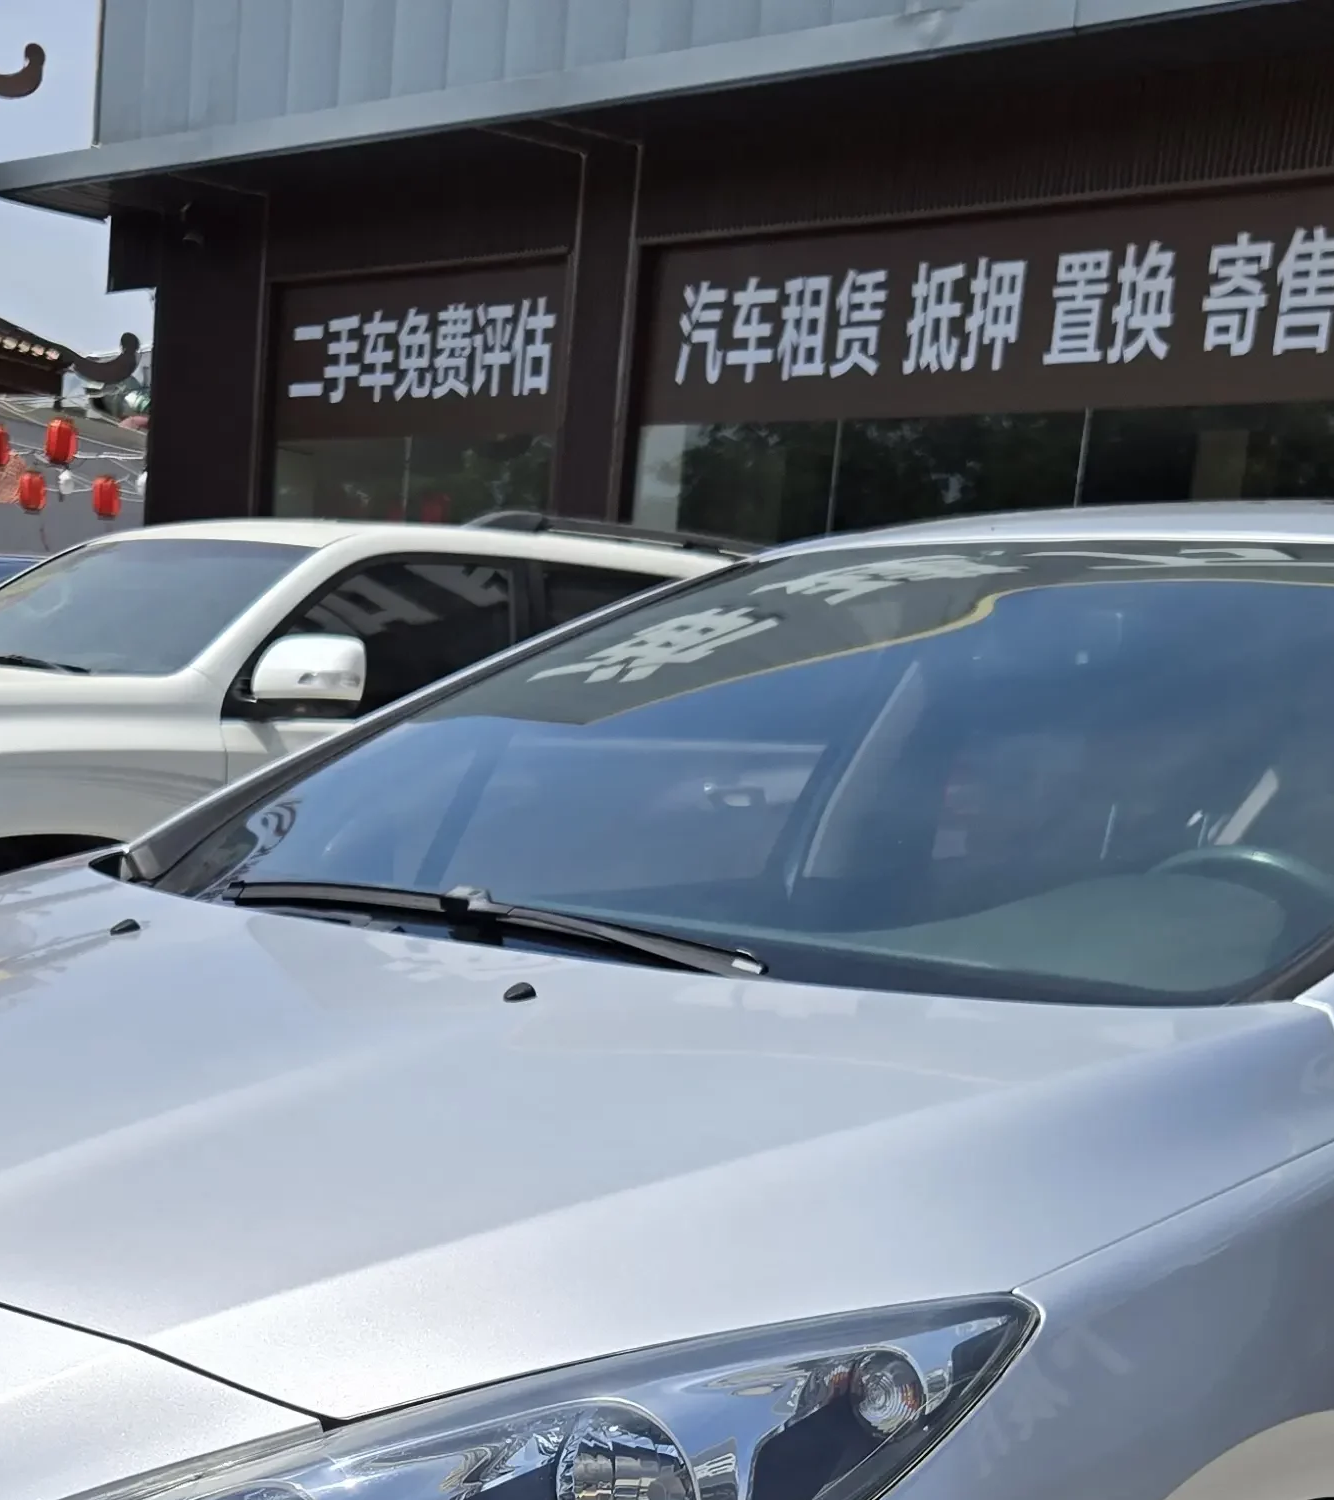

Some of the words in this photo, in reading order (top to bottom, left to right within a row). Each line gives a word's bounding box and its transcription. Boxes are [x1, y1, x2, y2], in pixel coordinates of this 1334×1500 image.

[288, 296, 556, 403] 二手车免费评估
[675, 268, 888, 385] 汽车租赁
[902, 257, 1028, 375] 抵押
[1043, 240, 1177, 366] 置换
